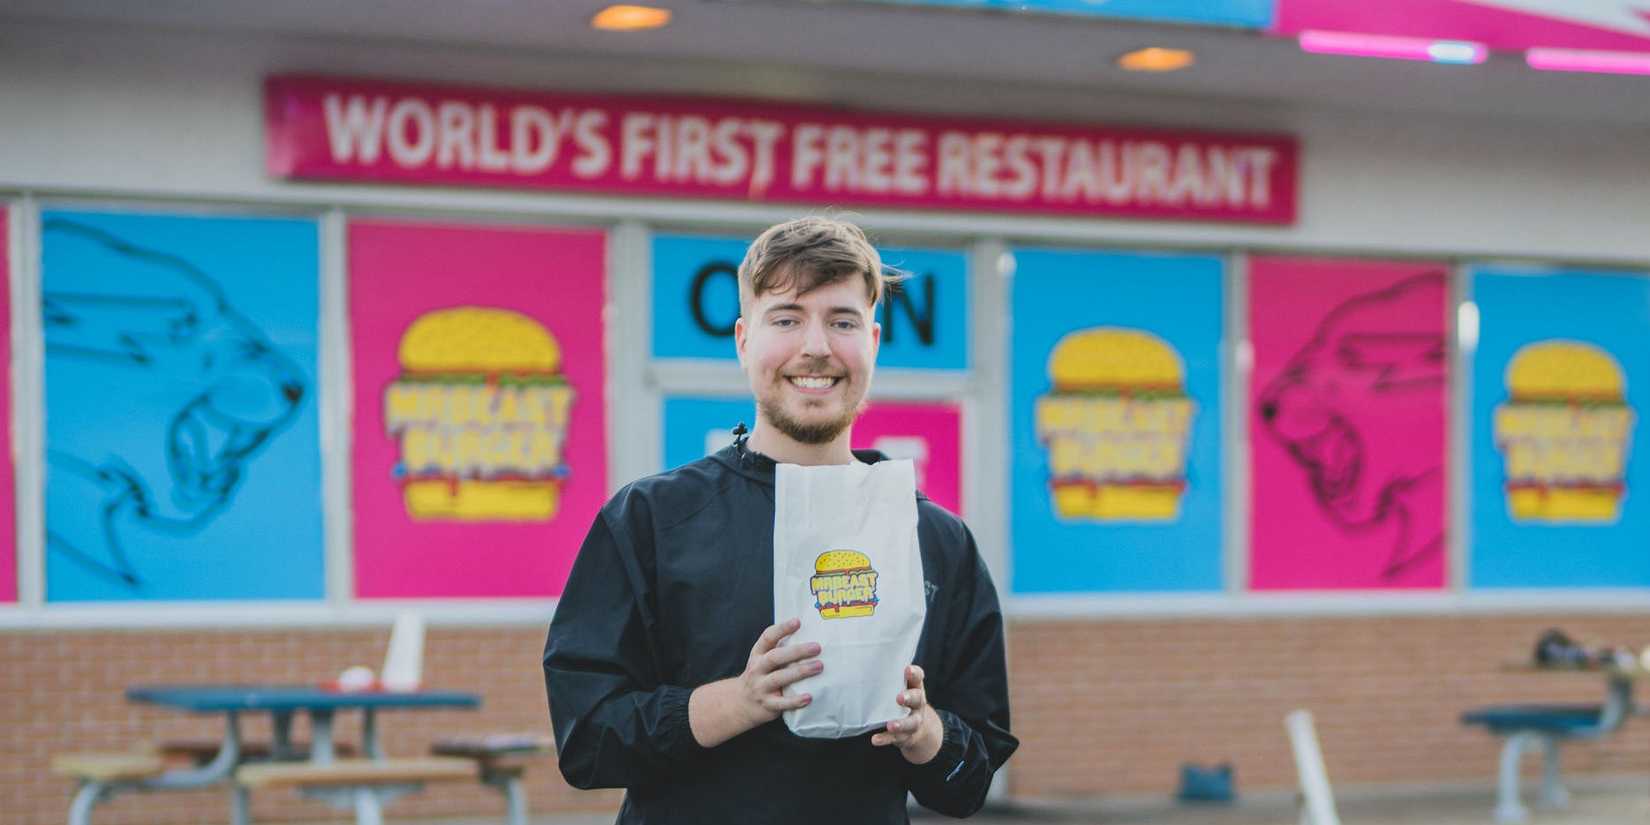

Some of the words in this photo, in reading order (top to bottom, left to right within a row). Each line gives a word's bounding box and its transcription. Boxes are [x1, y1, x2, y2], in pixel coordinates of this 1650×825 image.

[323, 94, 609, 178] WORLD'S
[621, 113, 783, 189] FIRST
[791, 121, 929, 194] FREE
[937, 131, 1276, 207] RESTAURANT
[688, 260, 937, 347] ON
